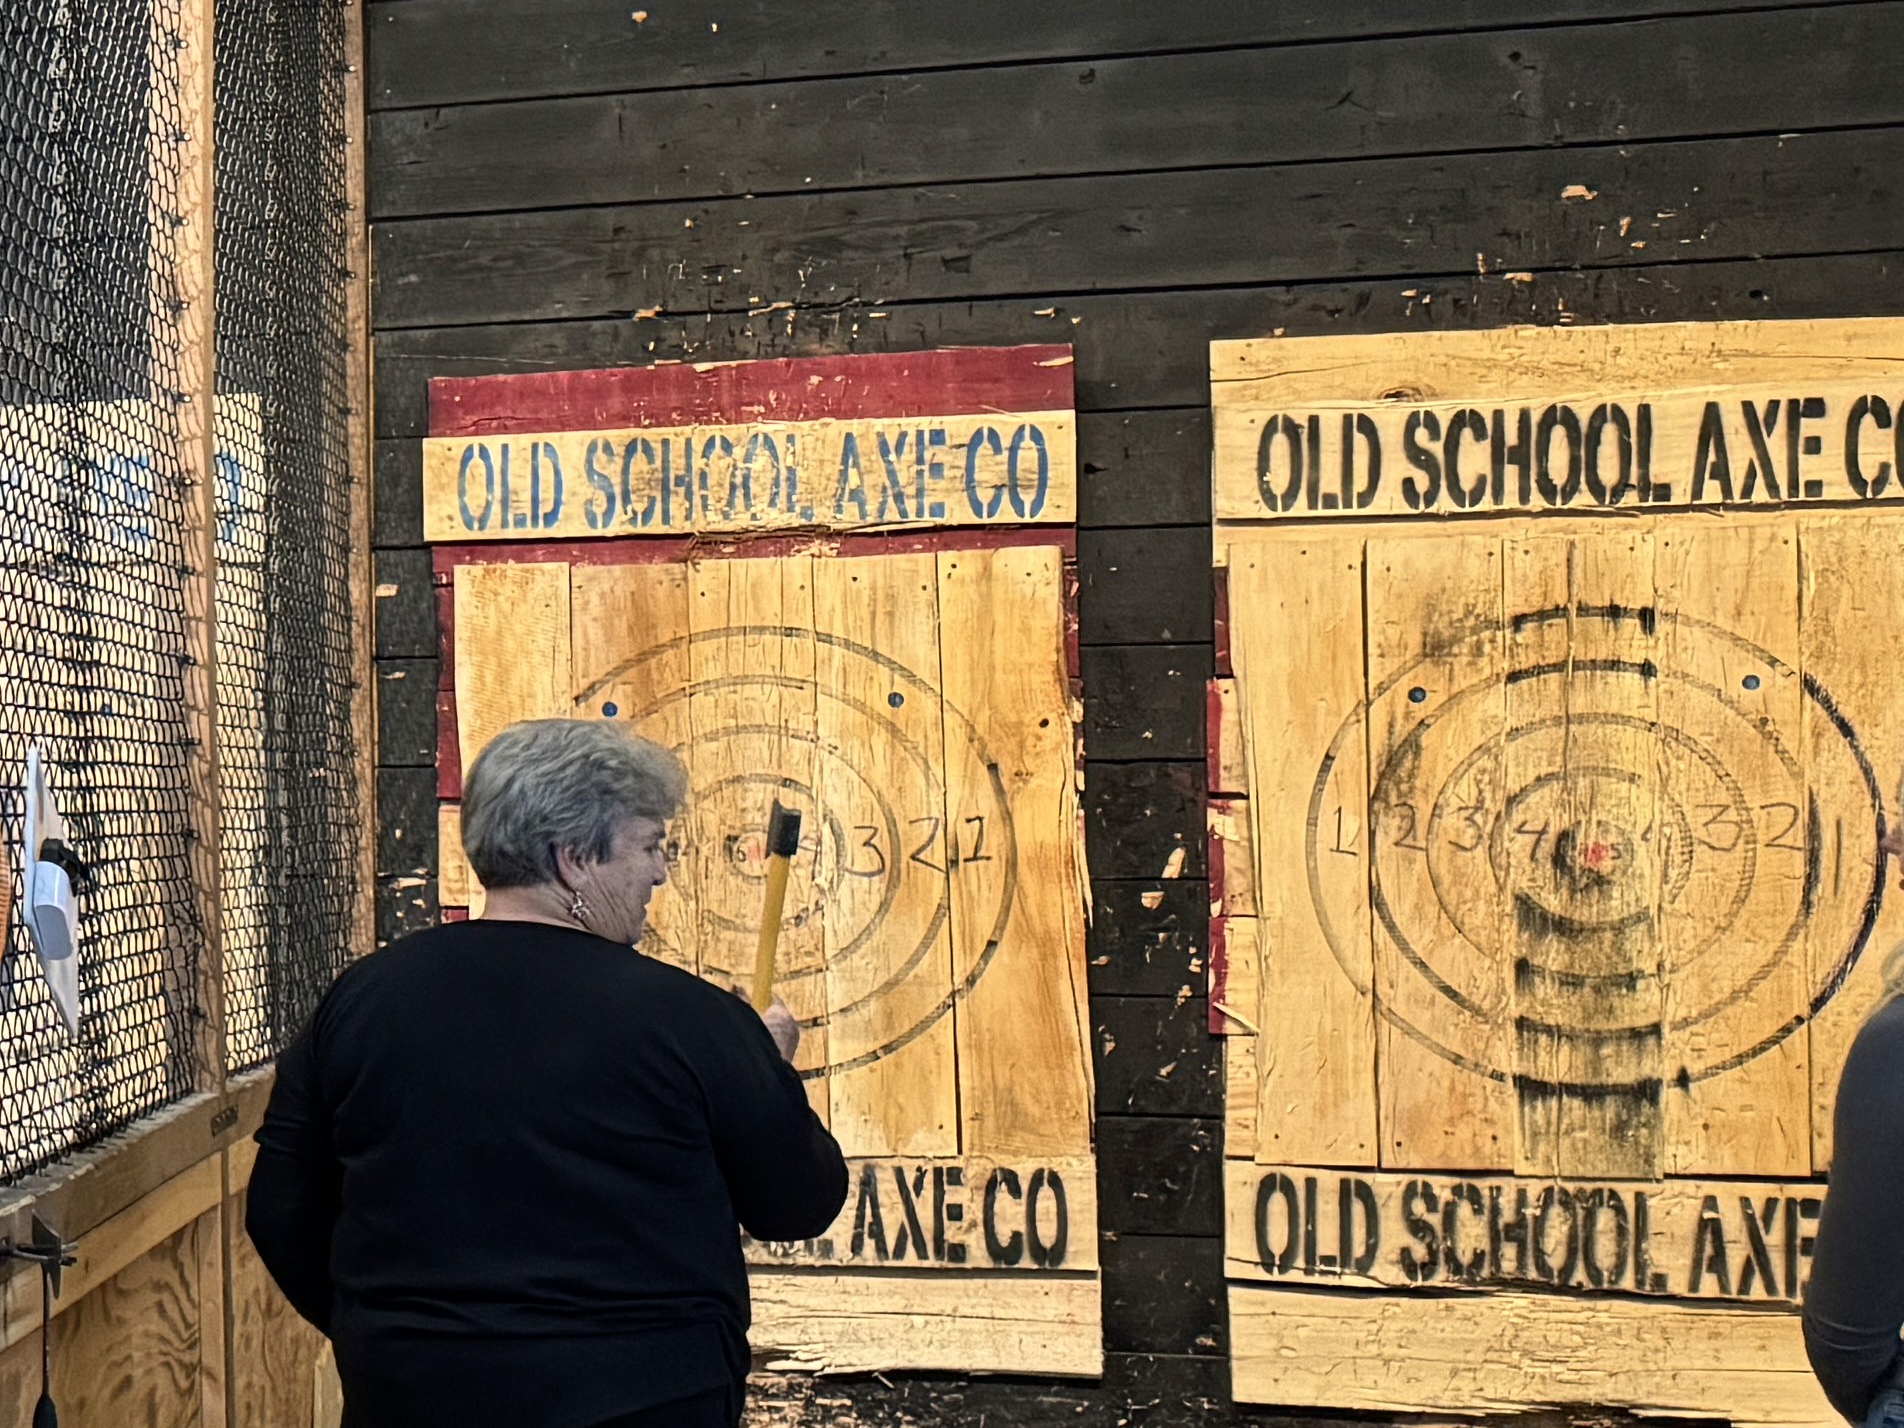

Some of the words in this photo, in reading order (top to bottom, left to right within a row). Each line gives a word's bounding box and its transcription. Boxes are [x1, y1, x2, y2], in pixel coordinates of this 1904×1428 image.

[458, 442, 563, 532] OLD
[583, 433, 814, 529] SCHOOL
[838, 429, 946, 522] AXE
[965, 423, 1049, 520] CO
[1257, 413, 1382, 512] OLD
[1403, 402, 1672, 509] SCHOOL
[1693, 397, 1826, 501] AXE
[1845, 394, 1904, 499] C
[844, 825, 886, 878] 3
[908, 816, 949, 874] 2
[963, 815, 993, 864] 1
[1329, 805, 1359, 857] 1
[1393, 801, 1427, 852] 2
[1447, 805, 1485, 852] 3
[1693, 803, 1743, 852] 3
[1759, 801, 1806, 852] 2
[851, 1164, 967, 1263] AXE
[983, 1167, 1069, 1267] CO
[1255, 1172, 1380, 1276] OLD
[1399, 1179, 1674, 1293] SCHOOL
